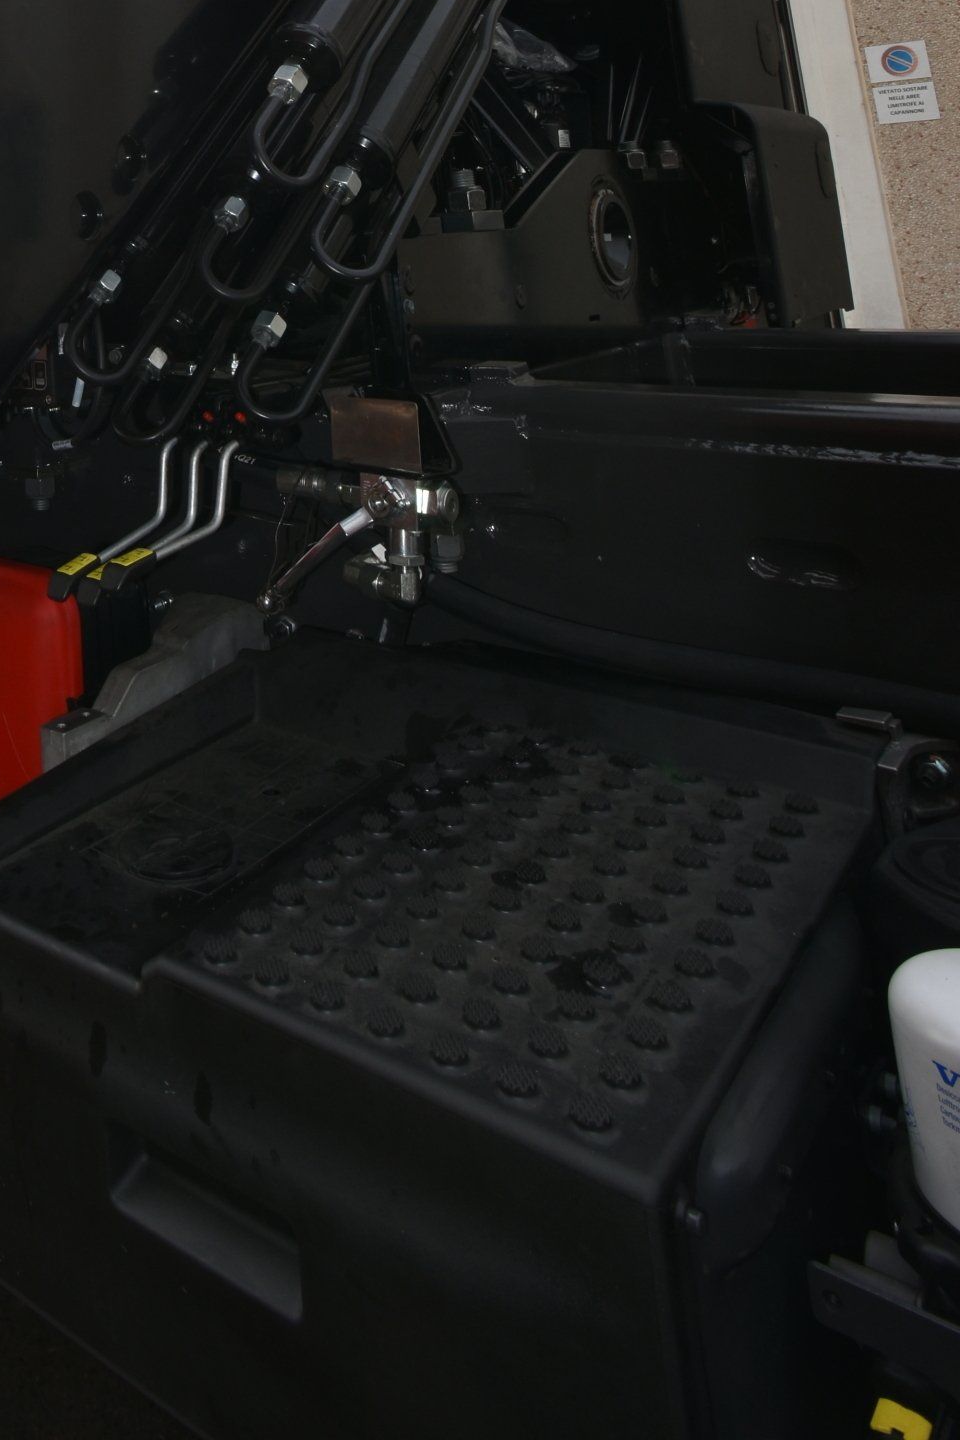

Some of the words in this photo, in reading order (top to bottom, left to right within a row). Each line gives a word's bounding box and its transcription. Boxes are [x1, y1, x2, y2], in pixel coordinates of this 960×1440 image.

[903, 85, 928, 93] SOSTARE
[887, 101, 917, 109] LIMITROFE
[890, 108, 925, 116] CAPANNONI
